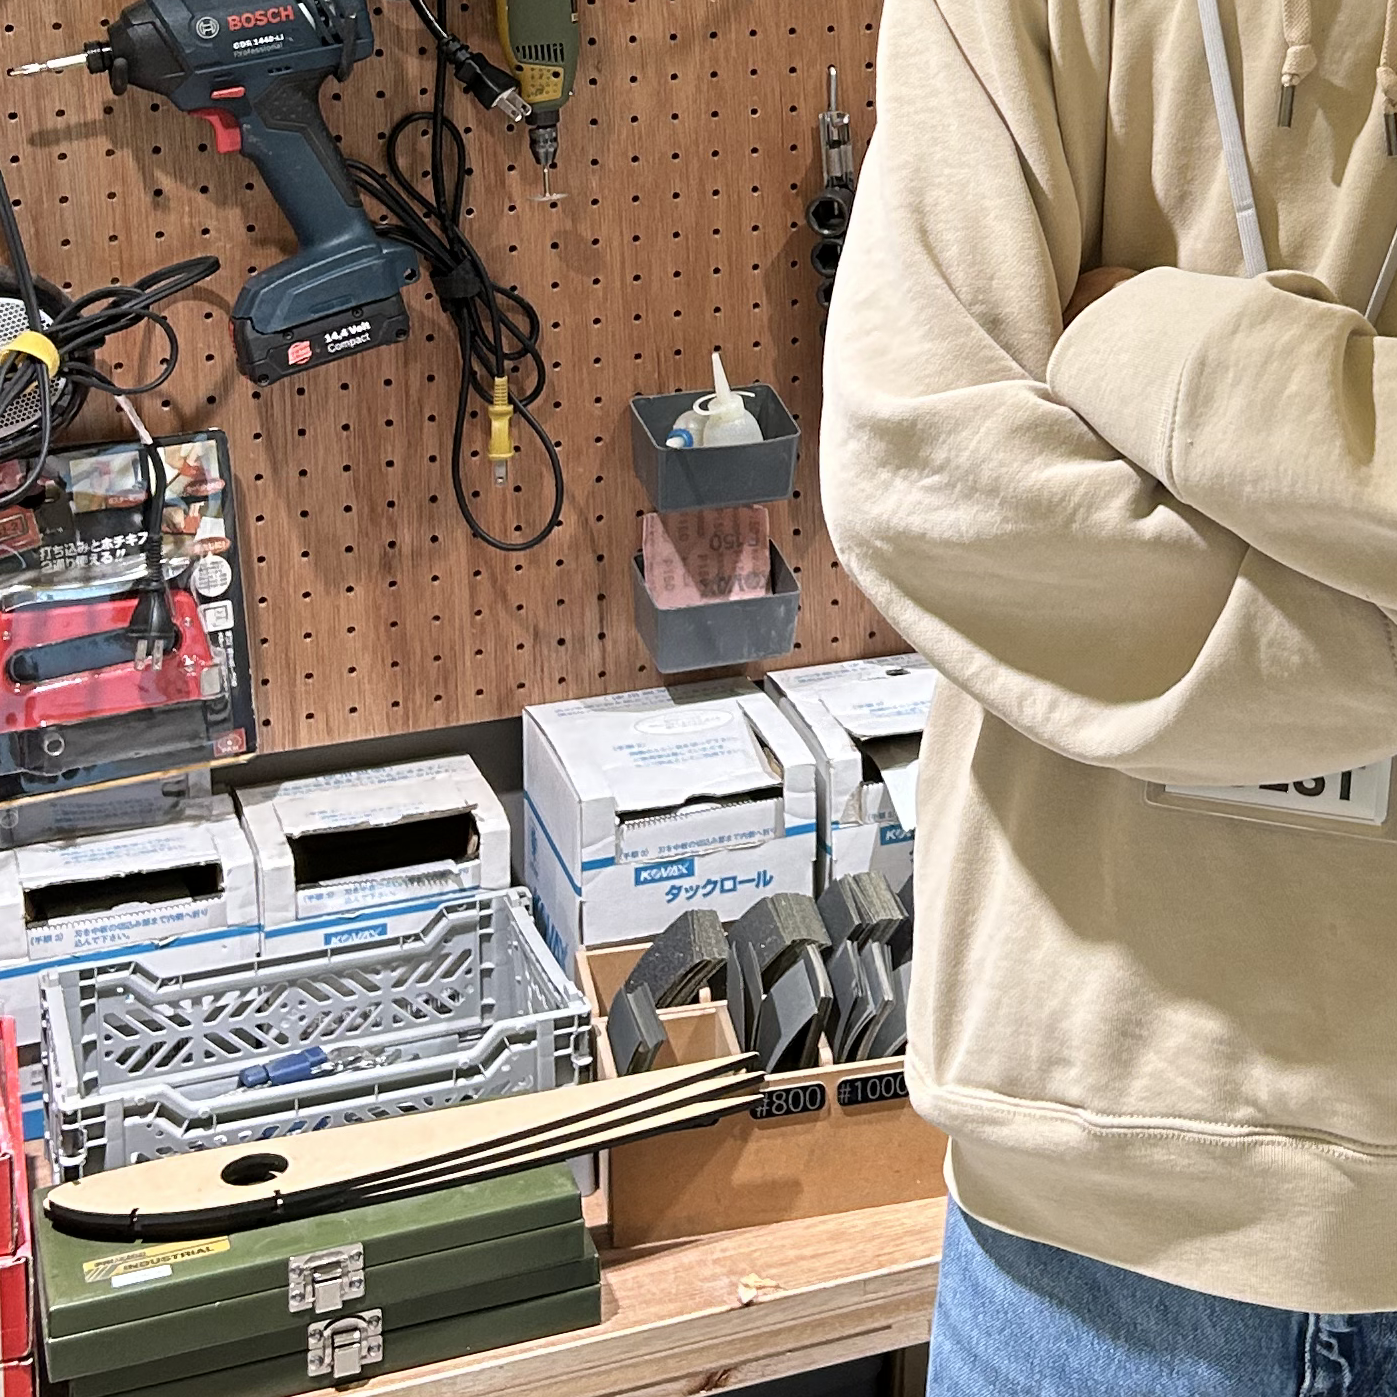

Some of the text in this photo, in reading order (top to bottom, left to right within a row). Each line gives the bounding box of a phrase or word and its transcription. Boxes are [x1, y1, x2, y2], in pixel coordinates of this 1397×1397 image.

[227, 5, 294, 31] BOSCH
[233, 43, 283, 58] Professional
[347, 321, 371, 334] Volt
[327, 333, 371, 353] Compact
[640, 863, 690, 882] KOVAX
[665, 870, 774, 903] タックロール
[123, 1246, 215, 1271] INDUSTRIAL
